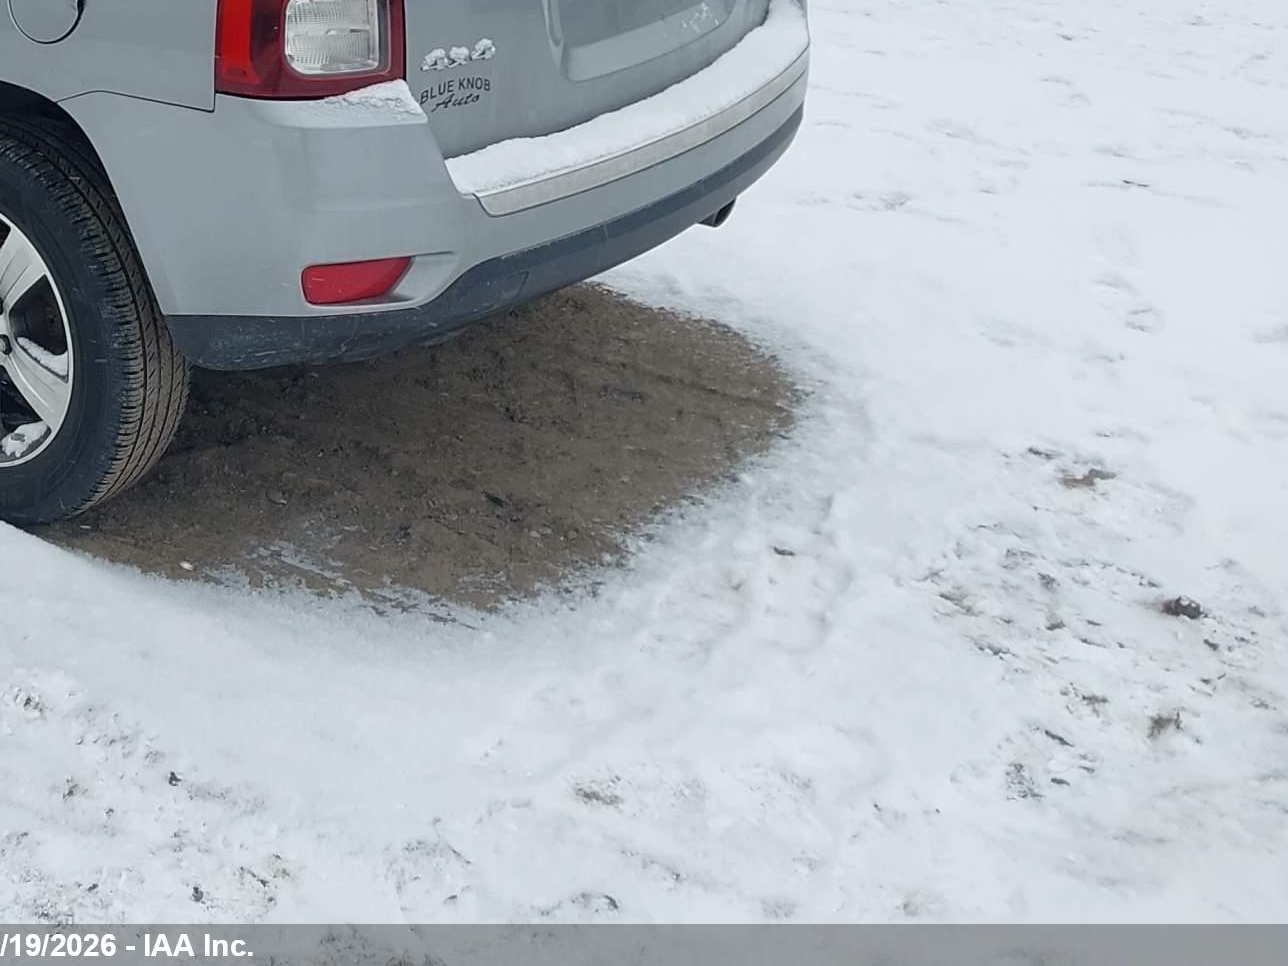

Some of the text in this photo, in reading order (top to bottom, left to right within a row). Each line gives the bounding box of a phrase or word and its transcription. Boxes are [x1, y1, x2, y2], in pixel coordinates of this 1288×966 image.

[419, 77, 491, 106] BLUE KNOB
[431, 93, 480, 113] Auto
